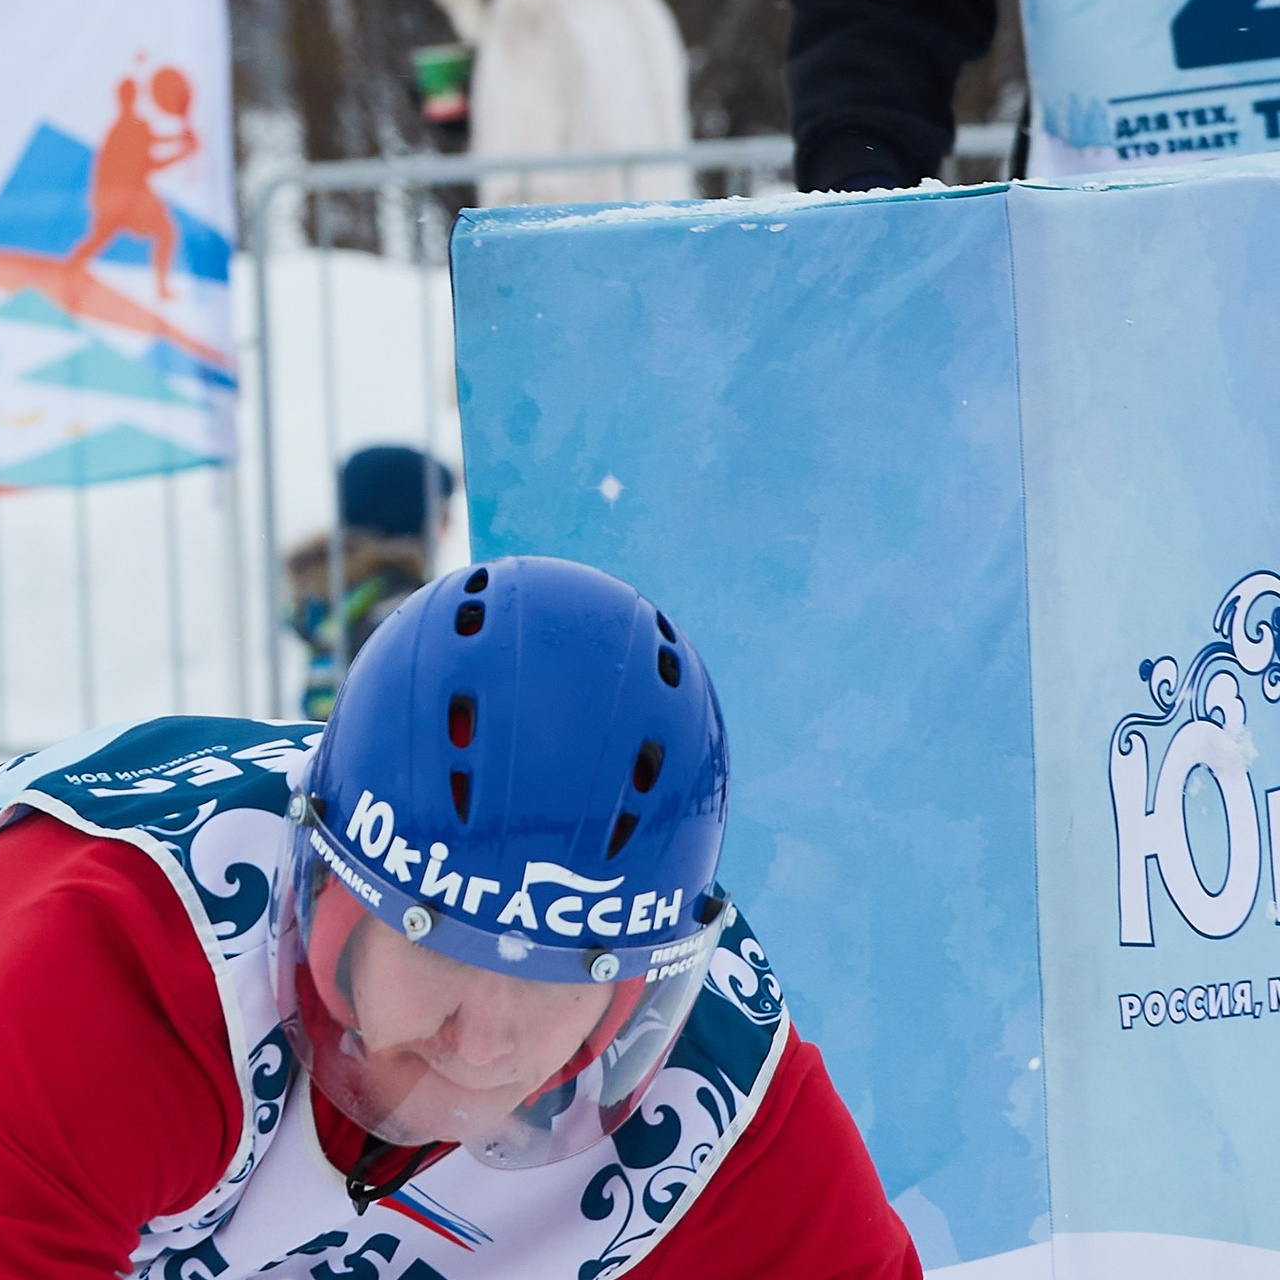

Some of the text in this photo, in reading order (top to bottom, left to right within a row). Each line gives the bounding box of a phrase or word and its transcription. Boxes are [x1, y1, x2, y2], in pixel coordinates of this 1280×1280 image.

[1118, 131, 1238, 161] КТО ЗНАЕТ
[309, 828, 383, 908] МУРМАНСК
[1118, 980, 1264, 1030] РОССИЯ,
